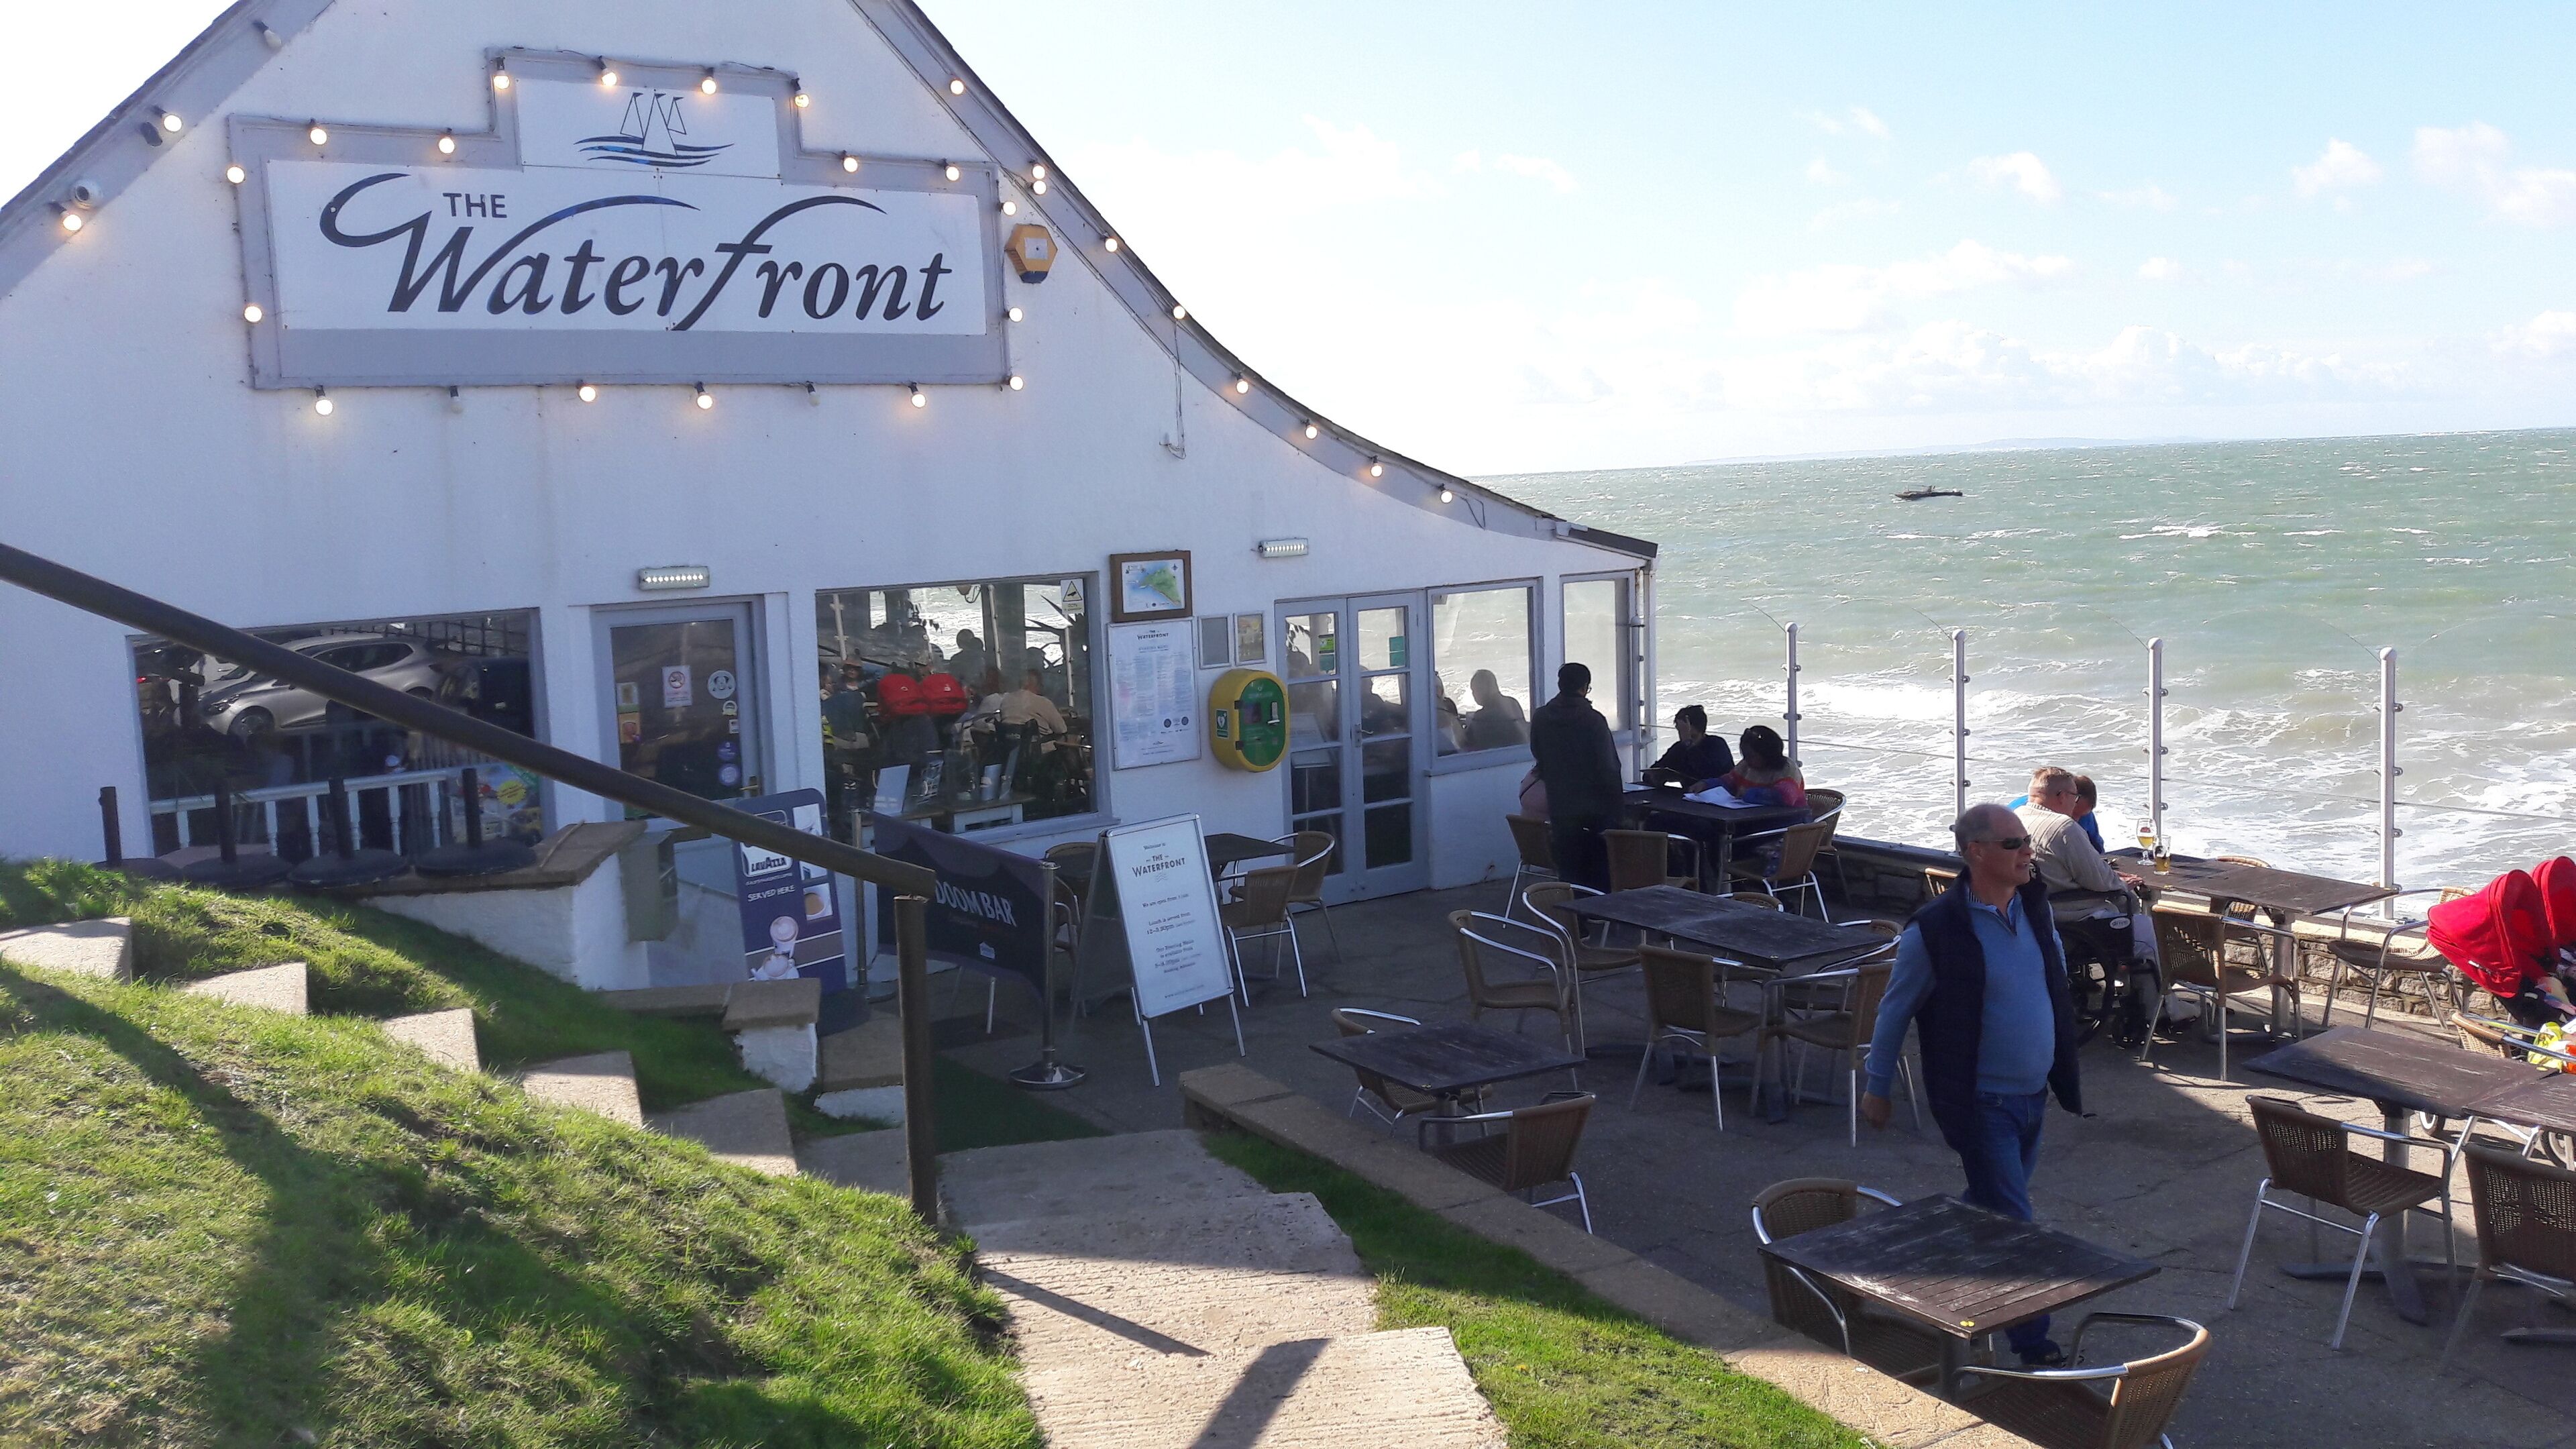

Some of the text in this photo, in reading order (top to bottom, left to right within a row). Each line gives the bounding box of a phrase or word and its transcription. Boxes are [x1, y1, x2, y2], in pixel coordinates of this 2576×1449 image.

[442, 193, 507, 220] THE
[319, 172, 953, 331] Waterfront
[751, 857, 787, 872] LAVAZZA
[1132, 857, 1185, 878] WATERFRONT
[1152, 853, 1163, 862] THE
[747, 889, 776, 903] SERVED
[935, 879, 983, 916] DOOM
[979, 892, 1017, 927] BAR
